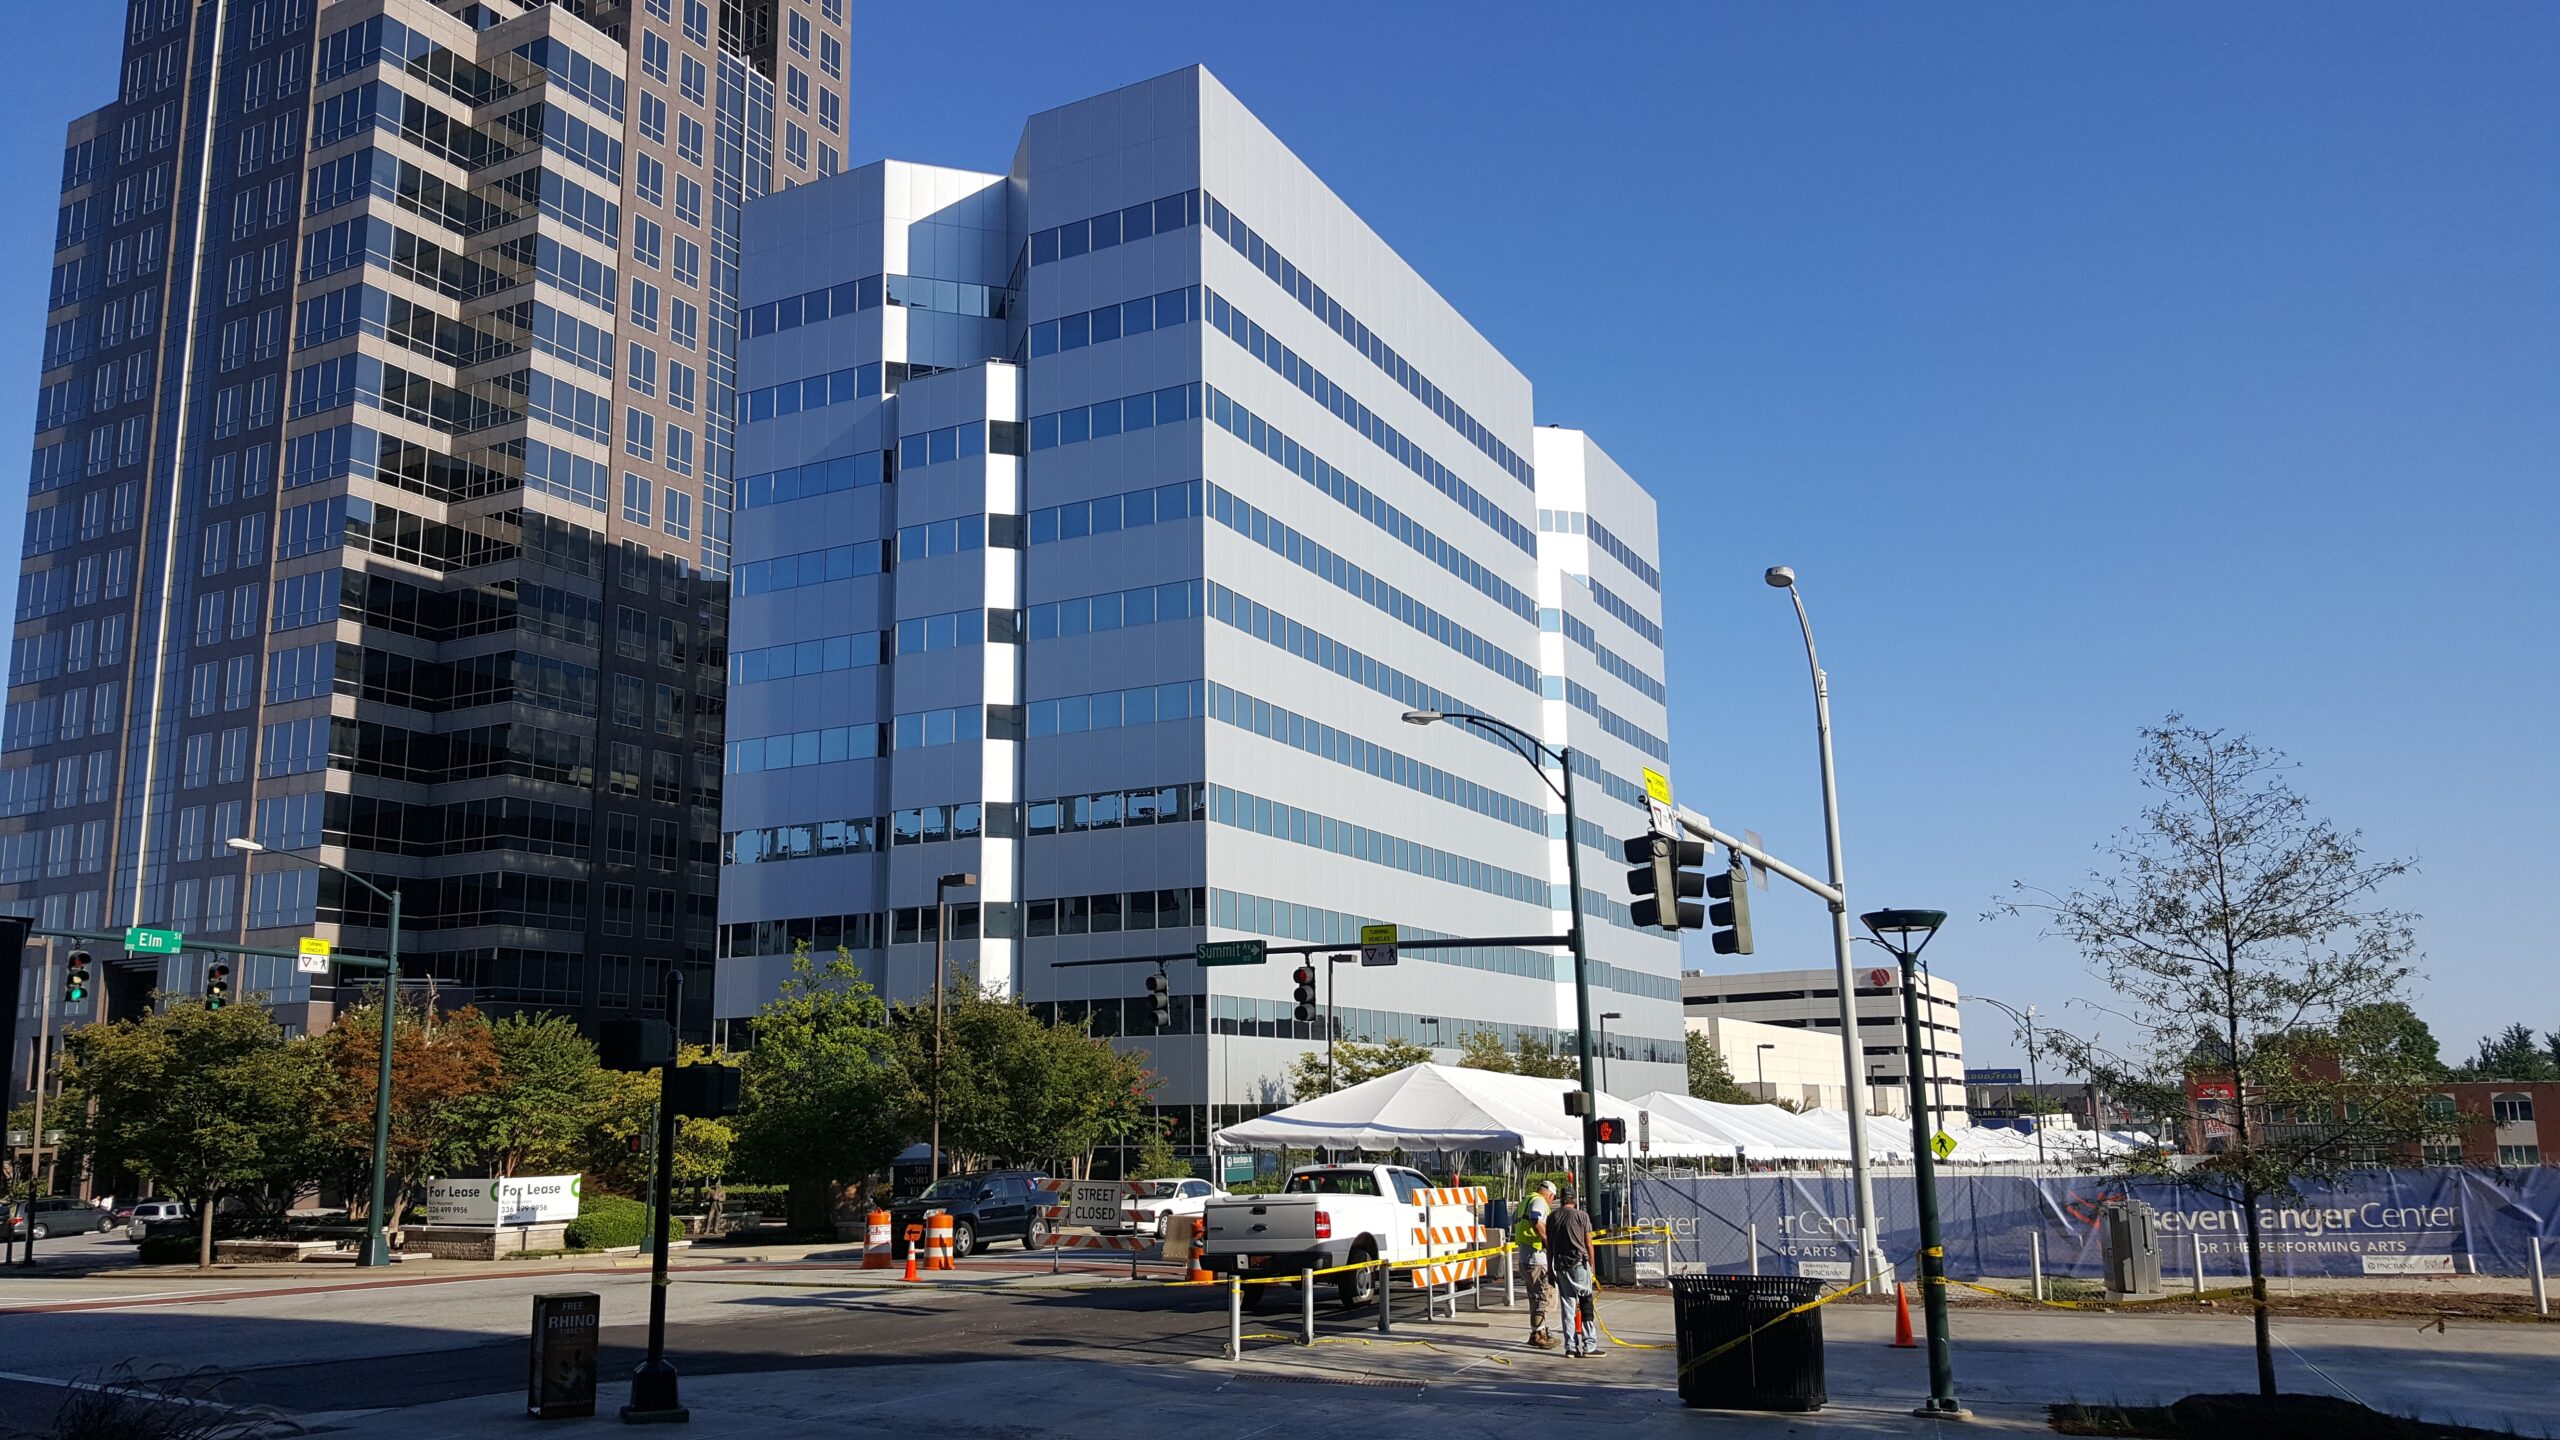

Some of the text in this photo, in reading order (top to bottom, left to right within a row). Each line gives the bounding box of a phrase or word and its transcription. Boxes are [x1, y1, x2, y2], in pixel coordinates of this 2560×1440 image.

[139, 932, 162, 947] Elm
[173, 932, 182, 940] St
[1198, 943, 1241, 960] Summit
[913, 1166, 928, 1175] 301
[904, 1176, 930, 1186] NORT
[429, 1185, 480, 1198] For Lease
[502, 1183, 561, 1197] For Lease
[1077, 1187, 1116, 1202] STREET
[428, 1206, 468, 1214] 336 499 9956
[500, 1206, 514, 1214] 336
[530, 1203, 548, 1212] 9956
[1075, 1206, 1116, 1221] CLOSED
[1799, 1210, 1885, 1235] Centr
[2239, 1203, 2357, 1237] anger
[2360, 1202, 2462, 1228] Center
[1802, 1246, 1837, 1257] ARTS
[2222, 1242, 2250, 1253] THE
[2259, 1240, 2361, 1253] PERFORMING
[2367, 1240, 2407, 1252] ARTS
[1708, 1293, 1731, 1301] Trash
[1756, 1294, 1781, 1303] Recycle
[562, 1301, 584, 1311] FREE
[548, 1313, 596, 1328] RHINO
[559, 1327, 585, 1336] TIMES
